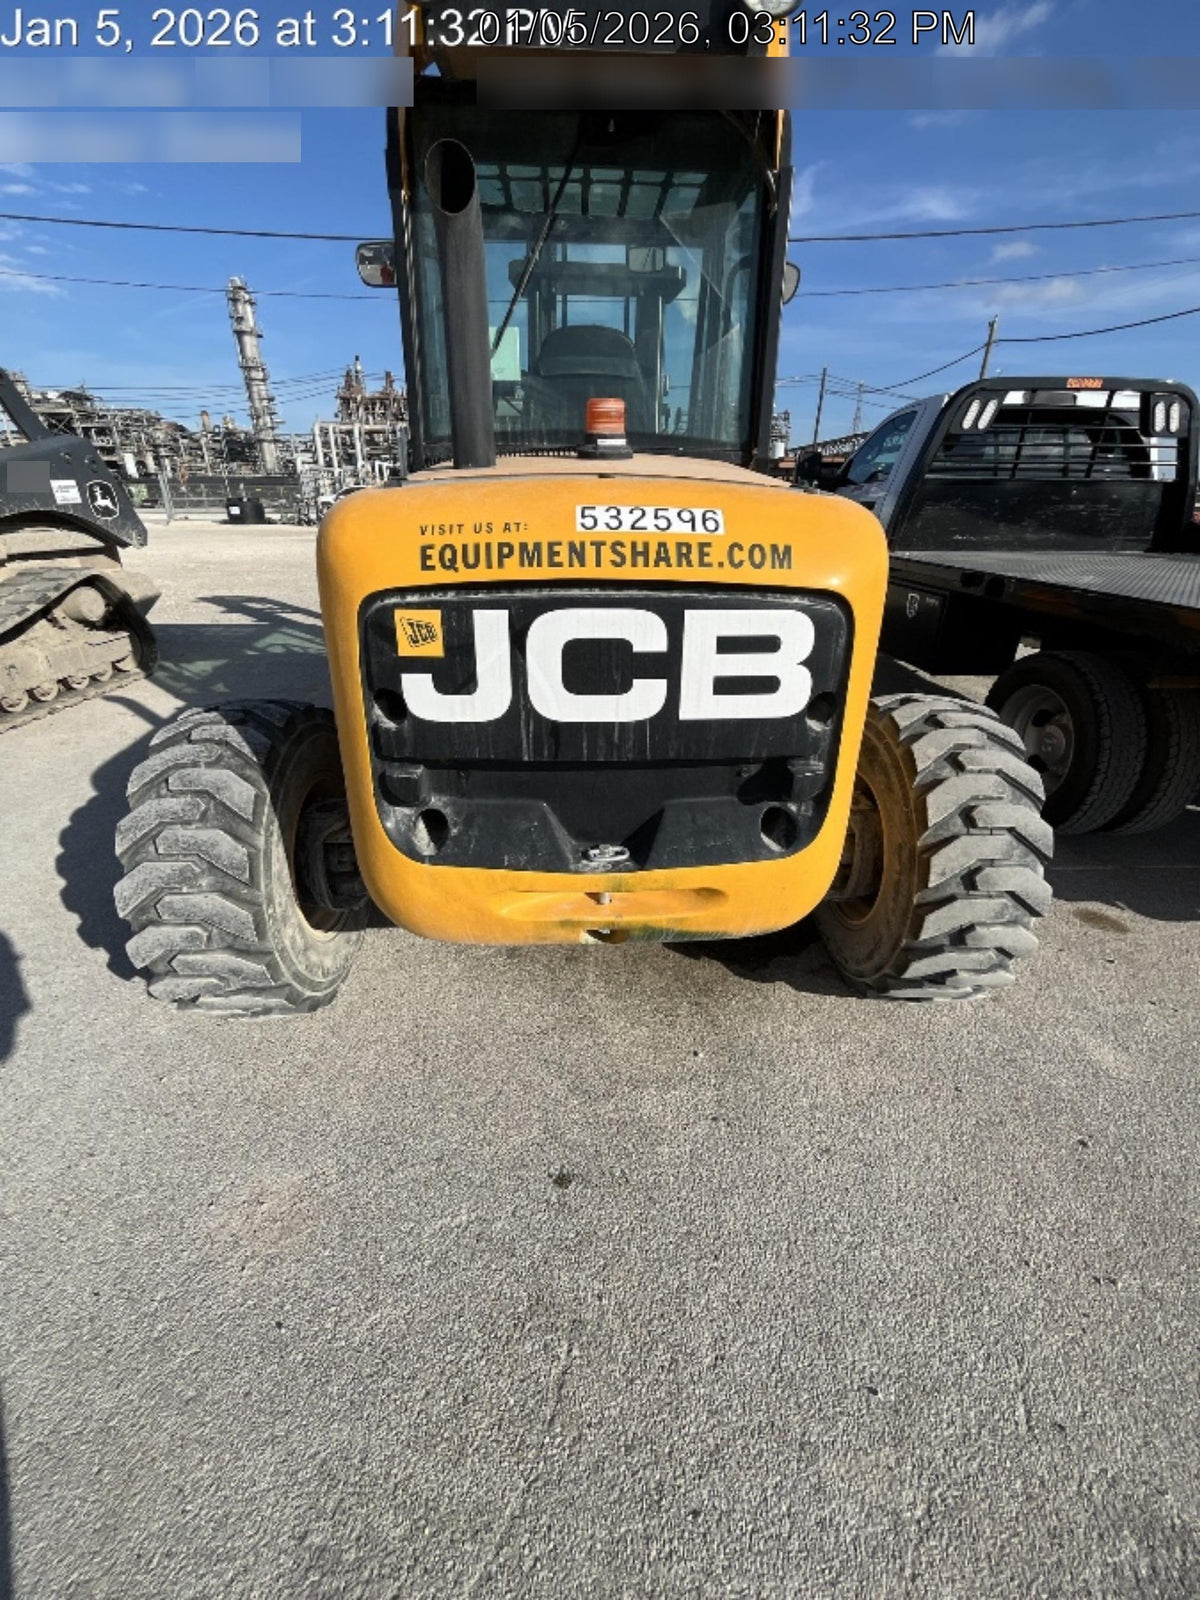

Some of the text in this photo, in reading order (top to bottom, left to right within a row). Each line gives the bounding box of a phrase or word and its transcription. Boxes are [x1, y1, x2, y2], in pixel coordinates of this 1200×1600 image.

[419, 521, 529, 536] VISIT US AT:
[580, 505, 720, 533] 532596
[419, 540, 792, 573] EQUIPMENTSHARE.COM
[406, 620, 434, 644] JCB
[401, 608, 815, 723] JCB
